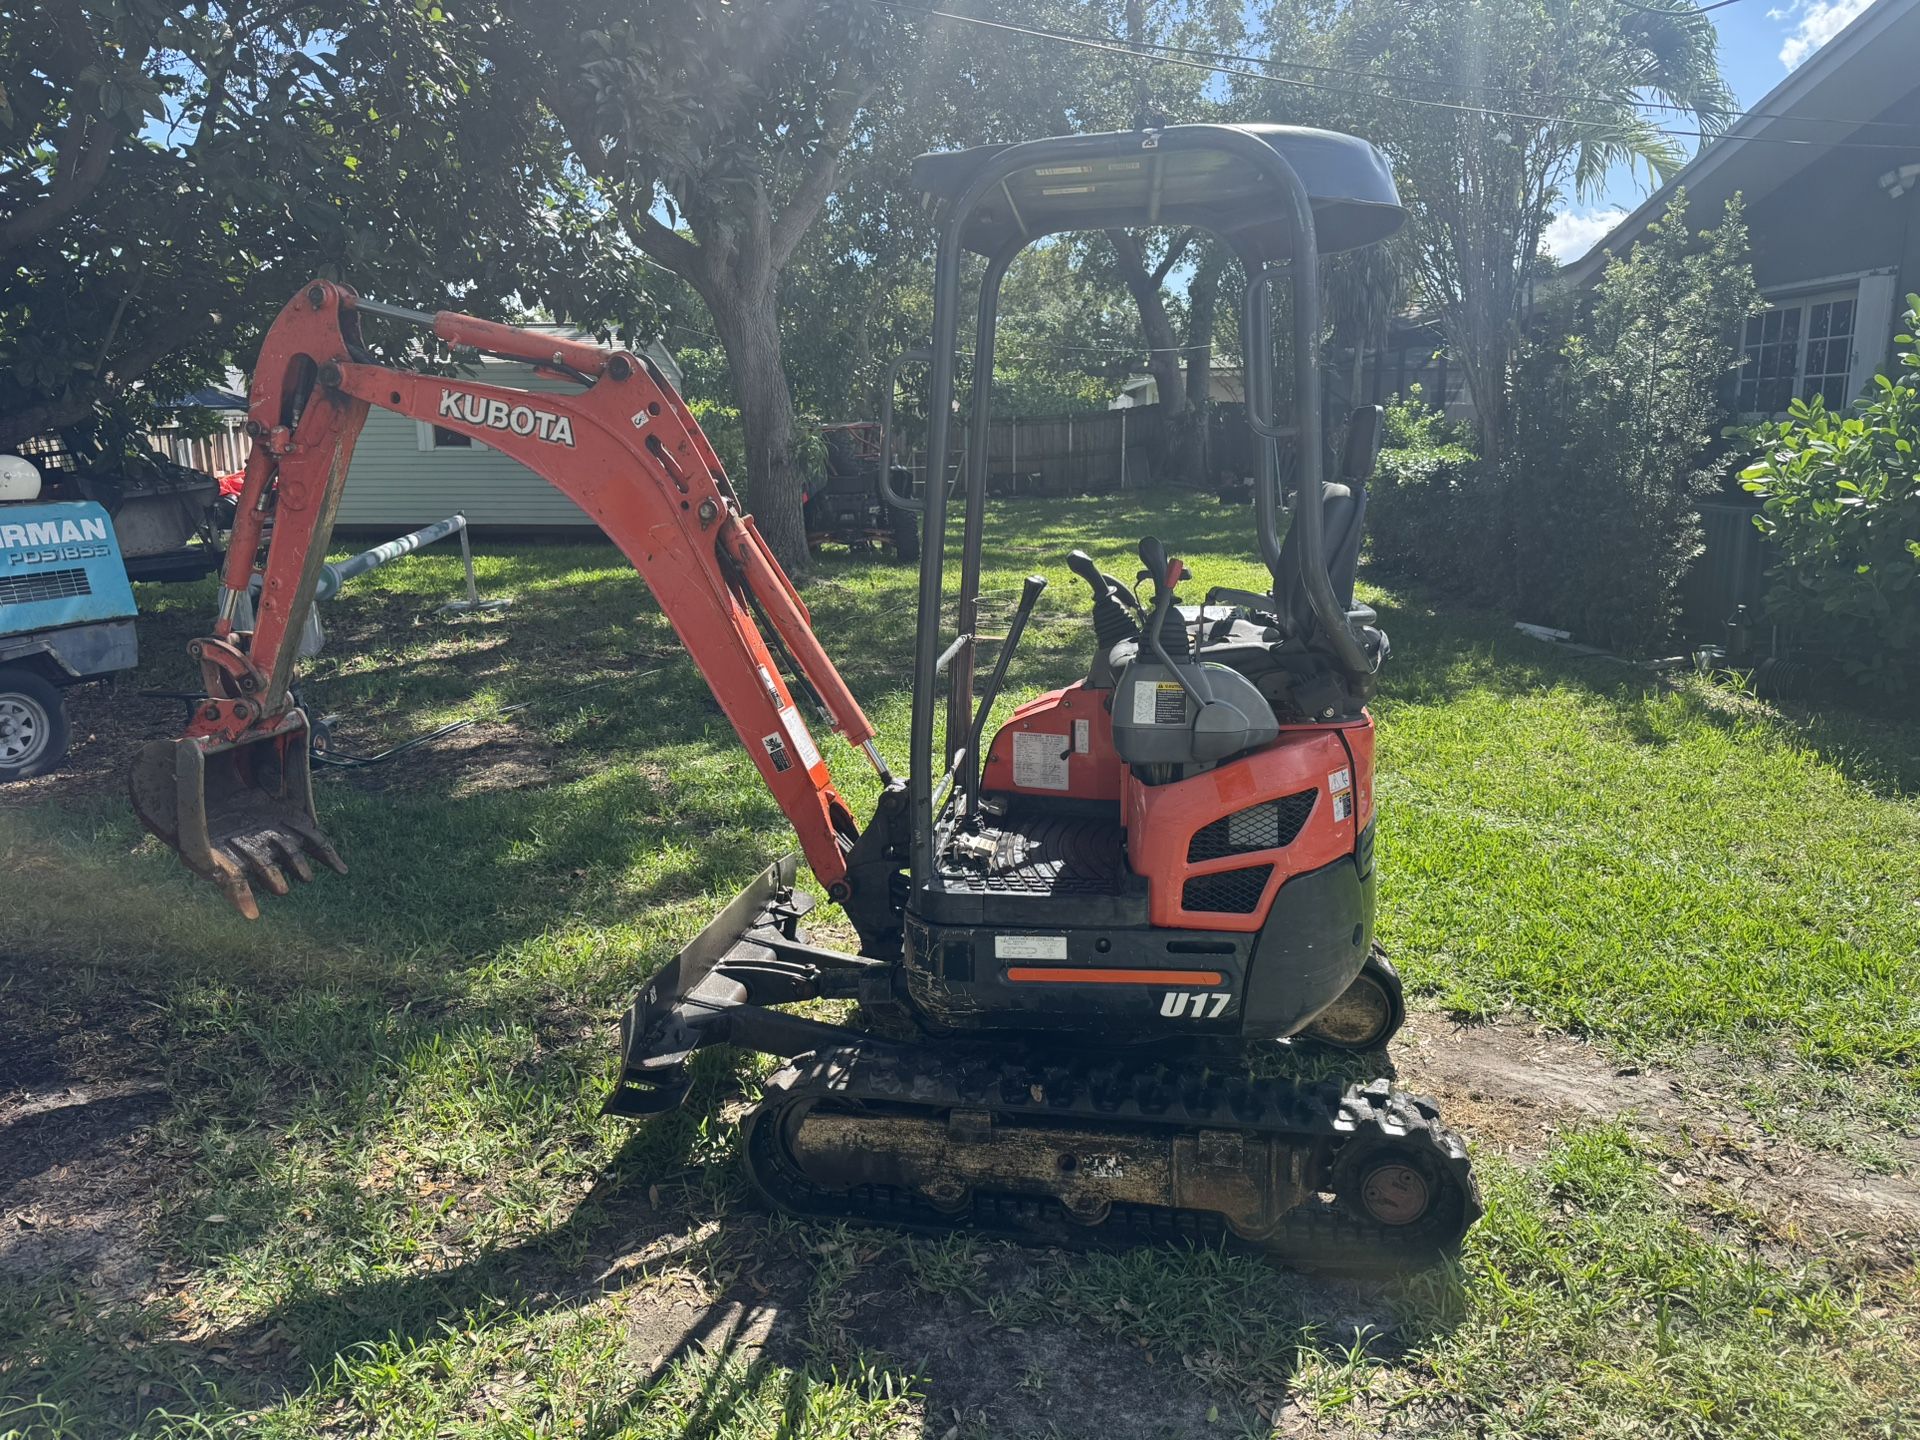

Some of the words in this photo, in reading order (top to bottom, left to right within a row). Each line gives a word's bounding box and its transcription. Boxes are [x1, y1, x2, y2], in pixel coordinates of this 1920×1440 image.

[439, 388, 575, 447] KUBOTA
[0, 518, 107, 548] RMAN
[1160, 992, 1231, 1018] U17
